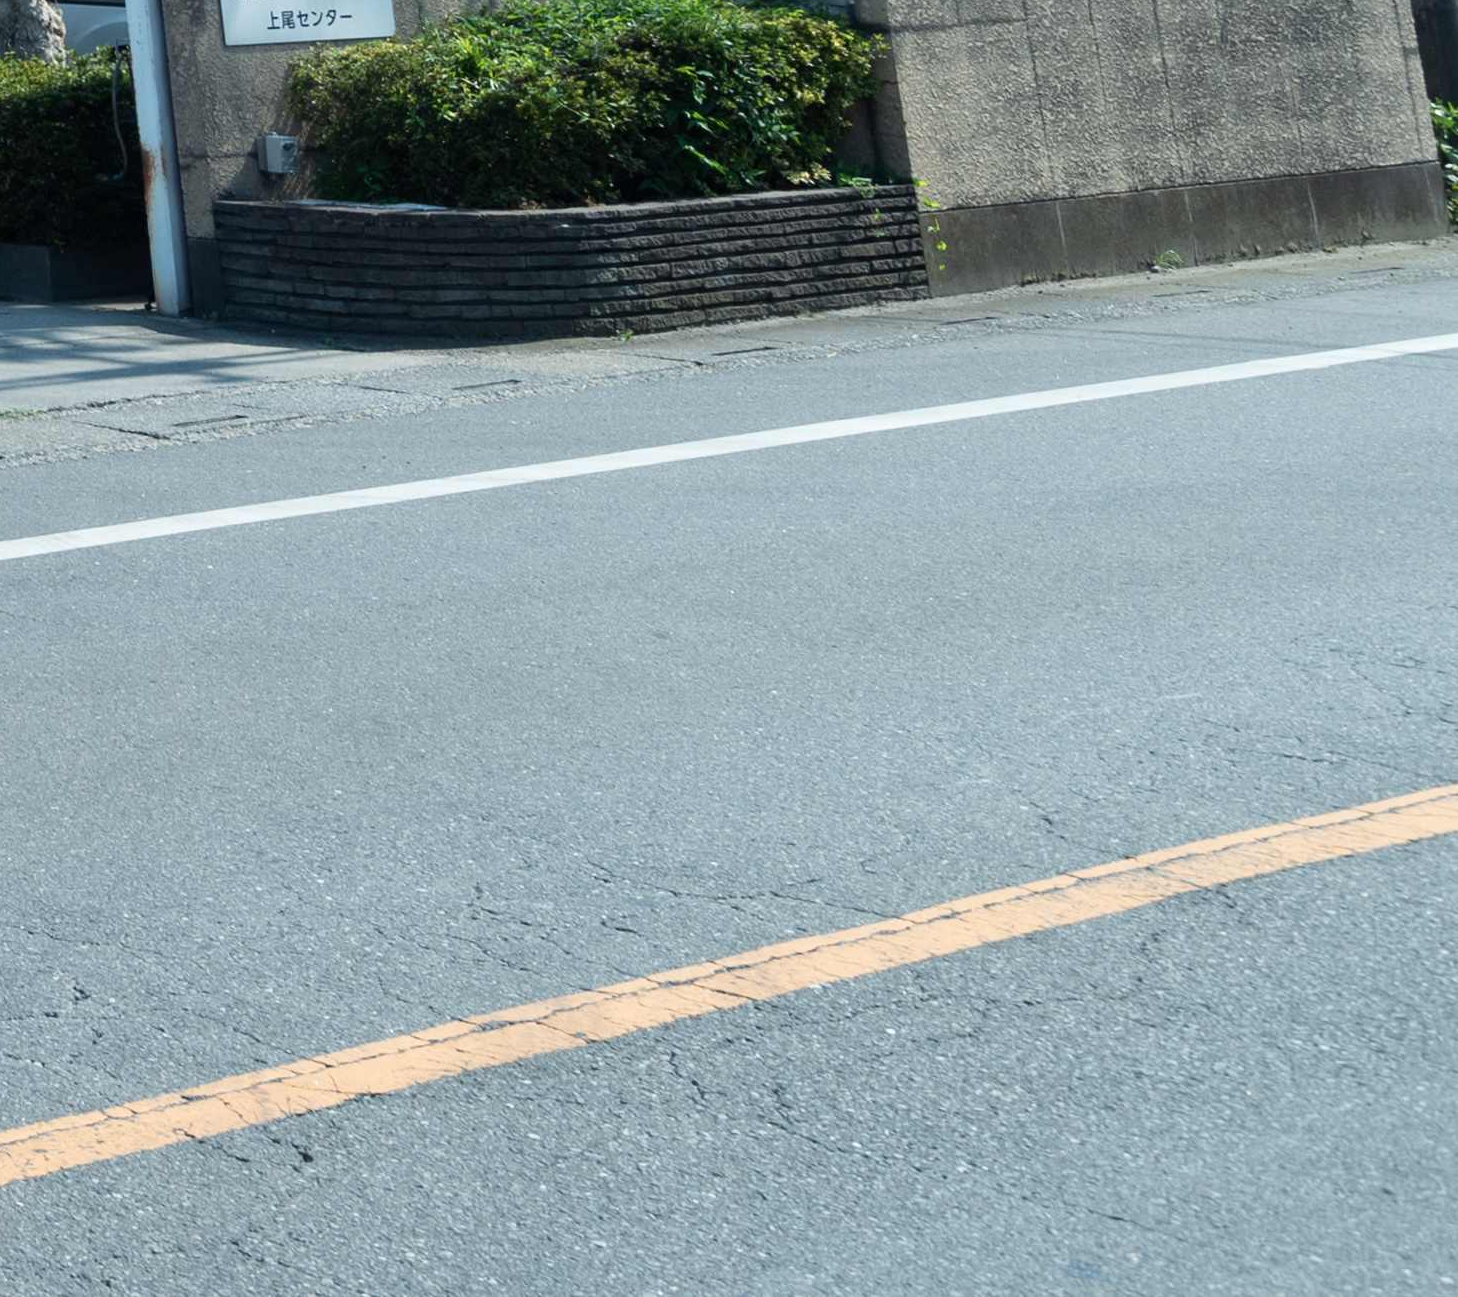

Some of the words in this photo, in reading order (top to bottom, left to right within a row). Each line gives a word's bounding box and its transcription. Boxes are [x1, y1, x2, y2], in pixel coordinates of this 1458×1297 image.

[266, 8, 353, 31] 上尾センター
